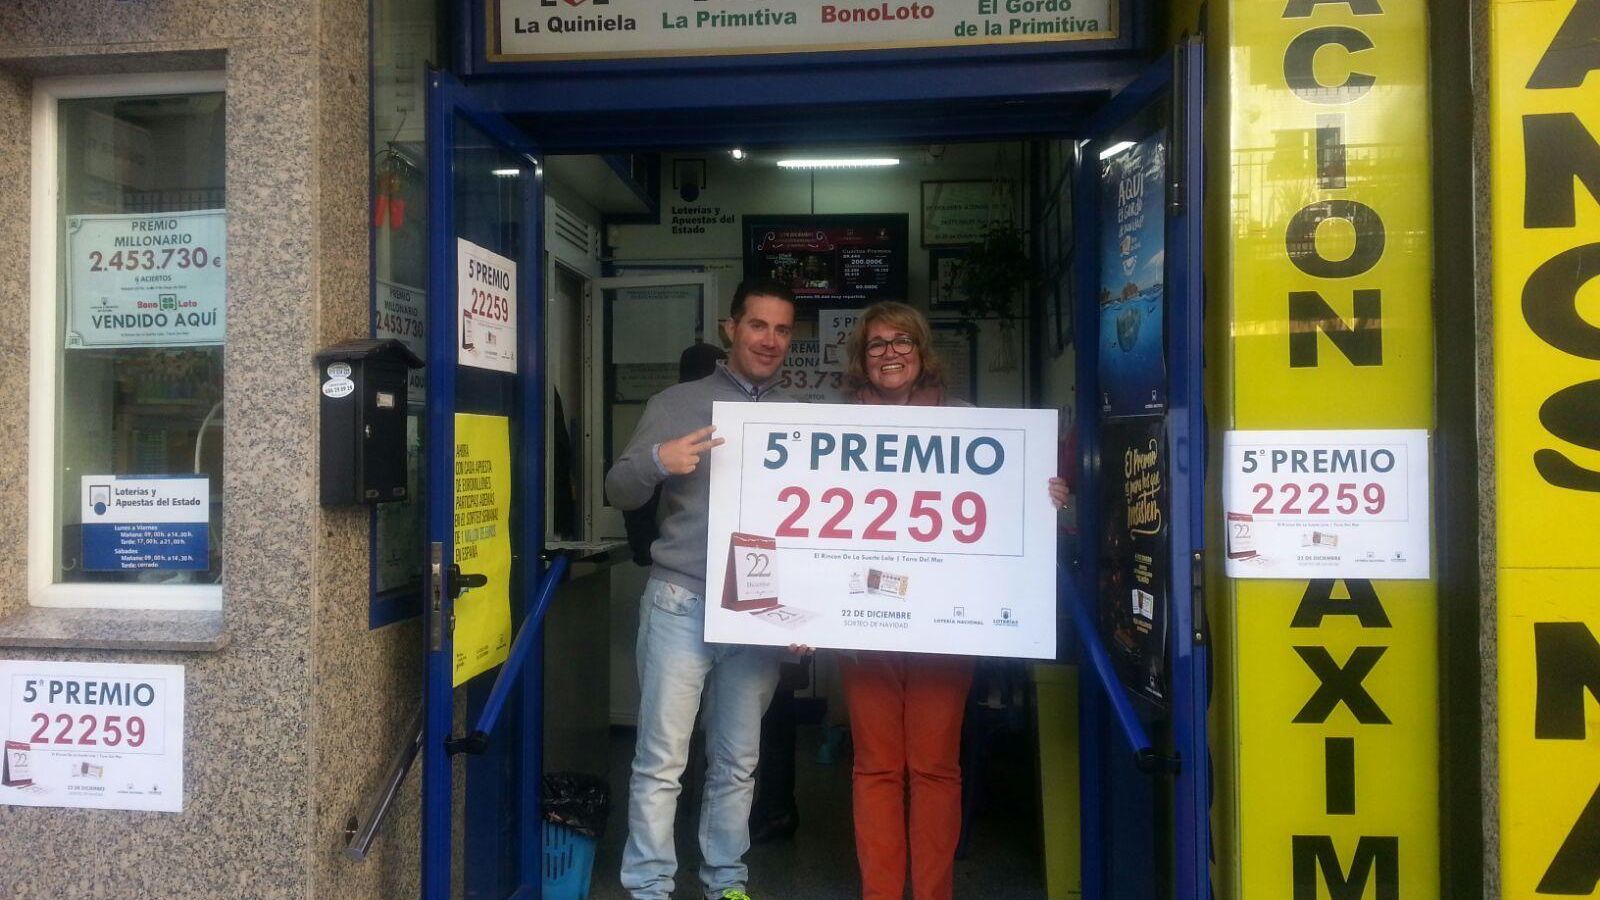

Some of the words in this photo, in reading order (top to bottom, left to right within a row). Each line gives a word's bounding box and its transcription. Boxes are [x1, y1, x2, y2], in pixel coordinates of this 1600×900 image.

[820, 2, 935, 24] BonoLoto
[977, 0, 999, 15] El
[1005, 0, 1072, 14] Gordo
[514, 17, 540, 34] La
[546, 15, 637, 35] Quiniela
[661, 12, 689, 29] La
[696, 9, 798, 29] Primitiva
[953, 20, 978, 38] de
[984, 19, 1003, 36] la
[1008, 16, 1100, 36] Primitiva
[1281, 0, 1386, 369] CION
[671, 205, 712, 216] Loterías
[713, 207, 721, 218] y
[671, 215, 718, 227] Apuestas
[720, 214, 735, 225] del
[131, 219, 178, 232] PREMIO
[671, 225, 705, 235] Estado
[114, 233, 192, 248] MILLONARIO
[88, 247, 209, 273] 2.453.730
[476, 261, 510, 291] PREMIO
[471, 287, 509, 323] 22259
[92, 313, 168, 329] VENDIDO
[174, 308, 218, 328] AQUÍ
[809, 431, 1005, 476] PREMIO
[1271, 448, 1396, 474] PREMIO
[115, 487, 149, 496] Loterías
[151, 488, 157, 498] y
[115, 499, 154, 509] Apuestas
[156, 498, 170, 506] del
[172, 497, 201, 506] Estado
[1252, 482, 1386, 515] 22259
[775, 485, 988, 544] 22259
[746, 552, 772, 578] 22
[841, 609, 852, 617] 22
[853, 610, 865, 618] DE
[866, 610, 912, 620] DICIEMBRE
[49, 680, 155, 707] PREMIO
[29, 712, 146, 748] 22259
